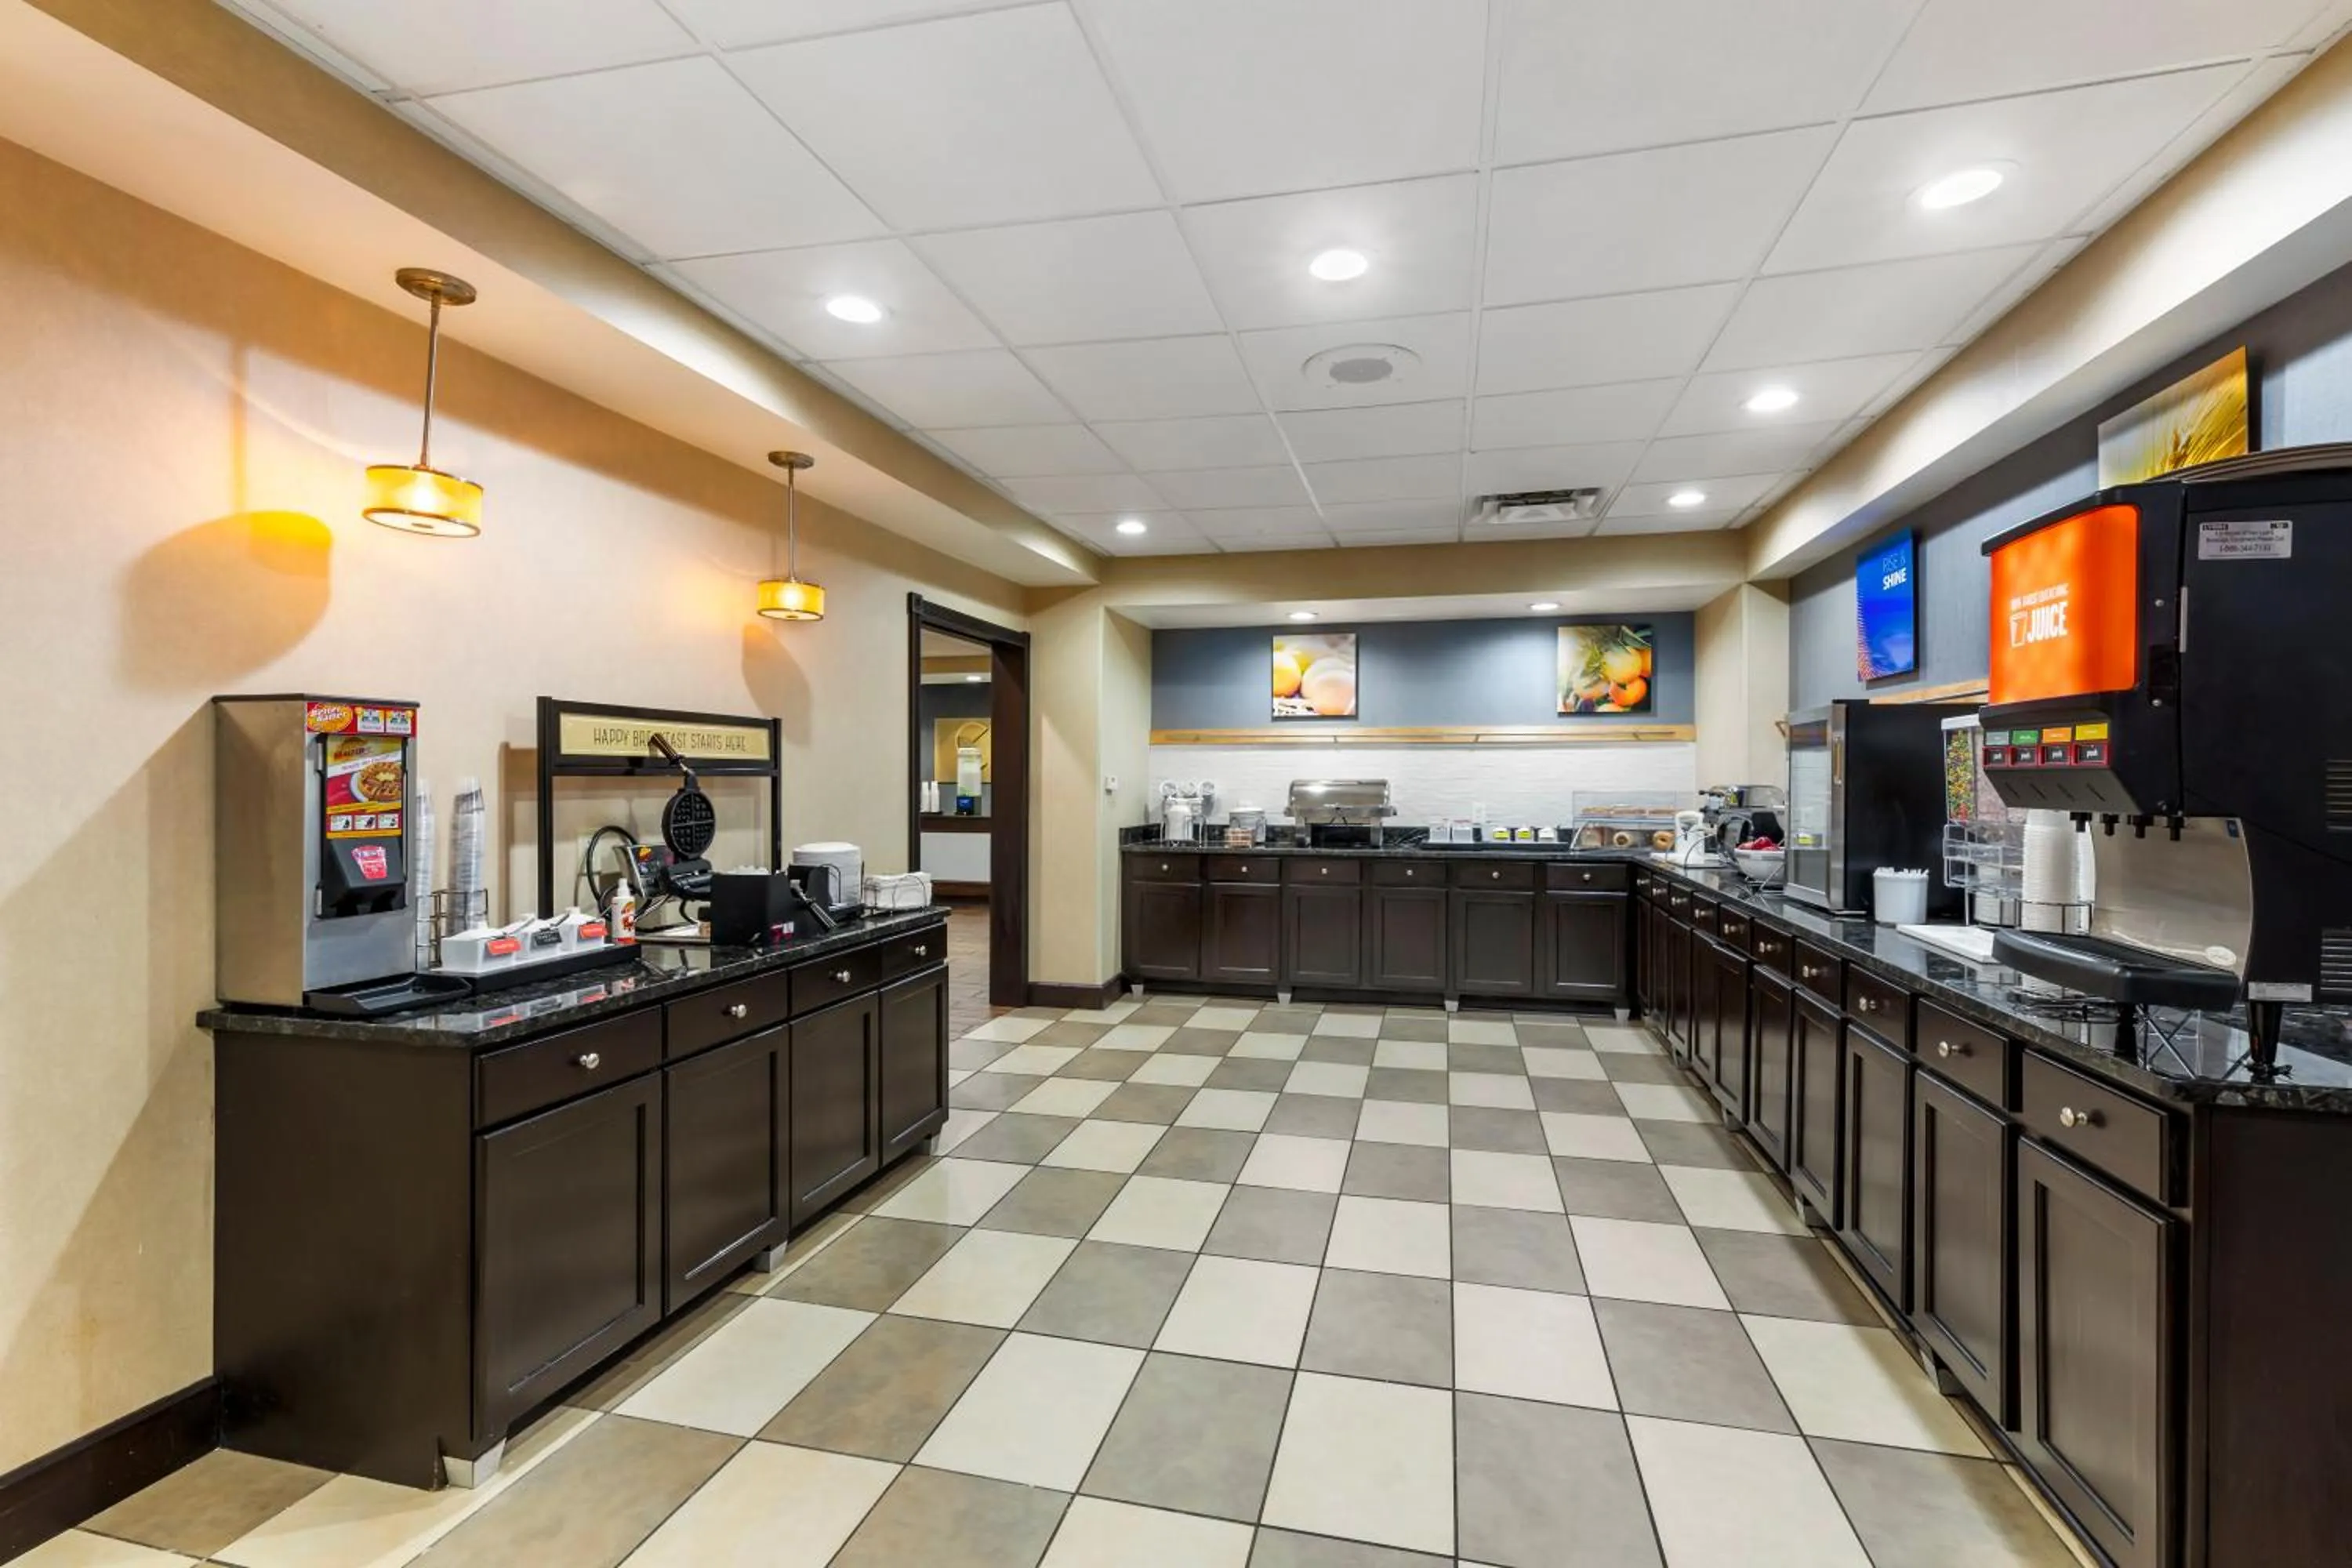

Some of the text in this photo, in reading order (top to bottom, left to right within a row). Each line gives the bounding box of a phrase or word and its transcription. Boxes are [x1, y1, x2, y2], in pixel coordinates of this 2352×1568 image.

[1882, 567, 1907, 590] SHINE
[2027, 601, 2068, 643] JUICE
[593, 727, 746, 752] HAPPY BREFAST STARTS HERE
